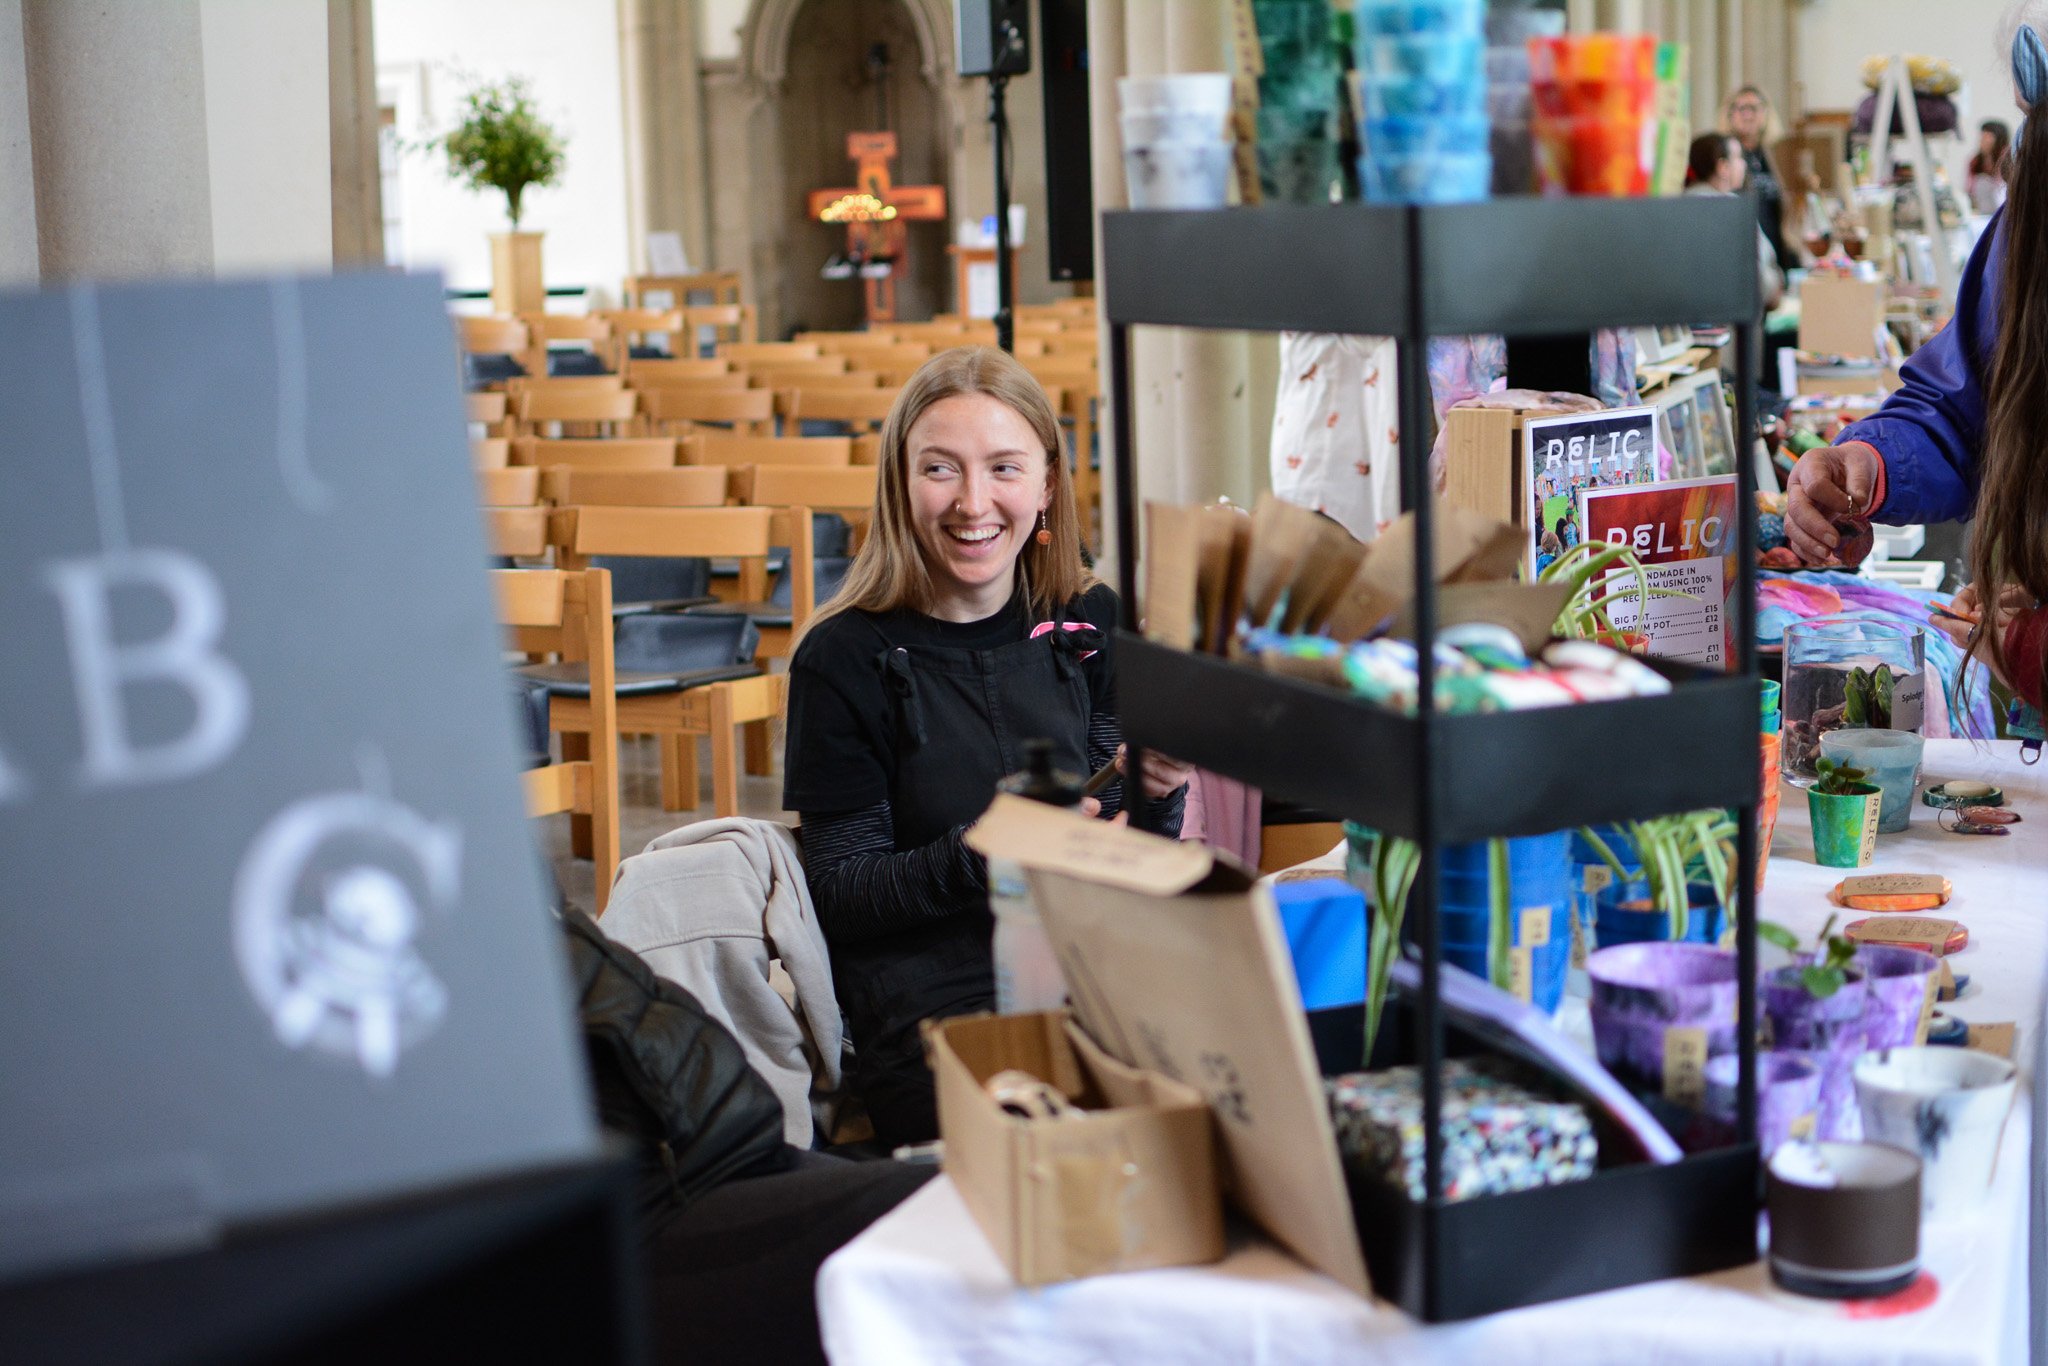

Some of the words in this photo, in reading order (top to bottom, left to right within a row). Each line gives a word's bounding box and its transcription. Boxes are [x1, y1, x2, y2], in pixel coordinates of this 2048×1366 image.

[1545, 429, 1641, 470] RELIC
[1634, 568, 1684, 581] HNDMADE
[1687, 566, 1696, 576] IN
[1662, 577, 1689, 589] USING
[1691, 574, 1713, 585] 100%
[1614, 615, 1630, 626] BIG
[1632, 613, 1650, 623] PT
[1704, 604, 1719, 614] £15
[1704, 614, 1719, 624] £12
[1708, 624, 1719, 633] £8
[1707, 644, 1720, 653] £11
[1705, 654, 1720, 664] £10
